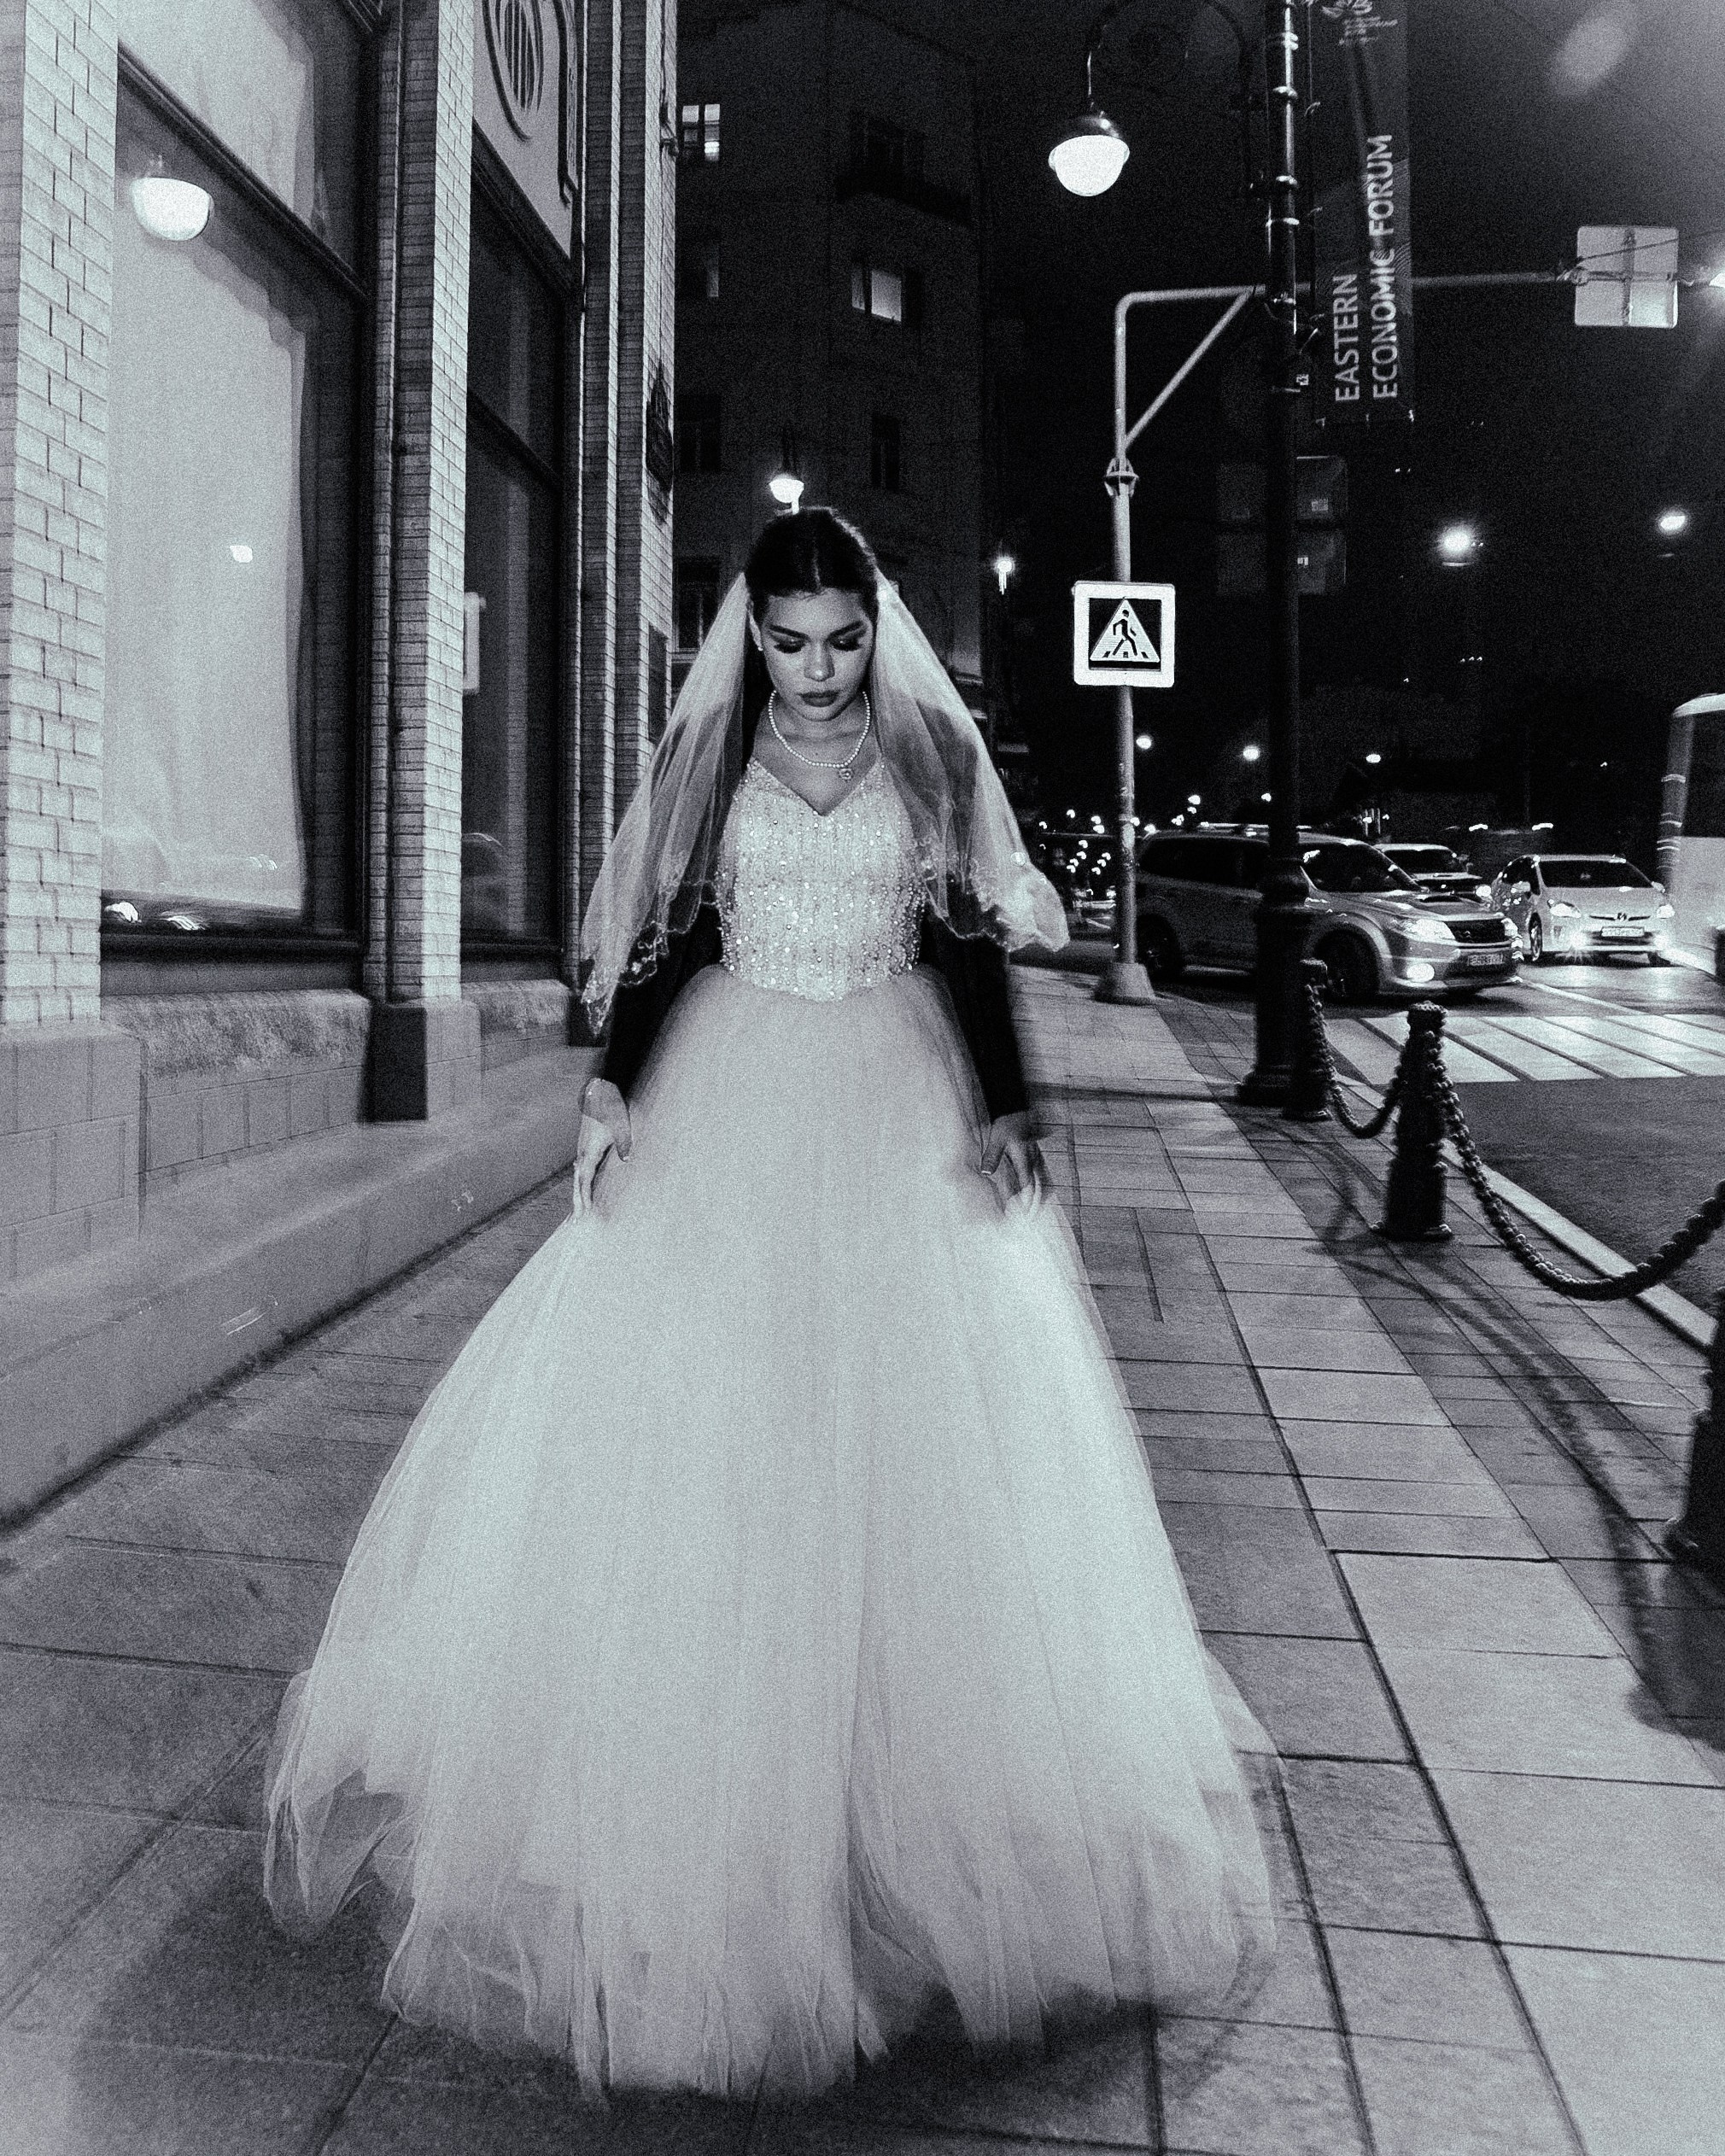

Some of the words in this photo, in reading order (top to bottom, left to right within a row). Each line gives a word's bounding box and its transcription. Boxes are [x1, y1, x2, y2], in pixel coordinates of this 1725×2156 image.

[1367, 134, 1394, 236] FORUM
[1333, 274, 1360, 400] EASTERN
[1369, 248, 1398, 398] ECONOMIC
